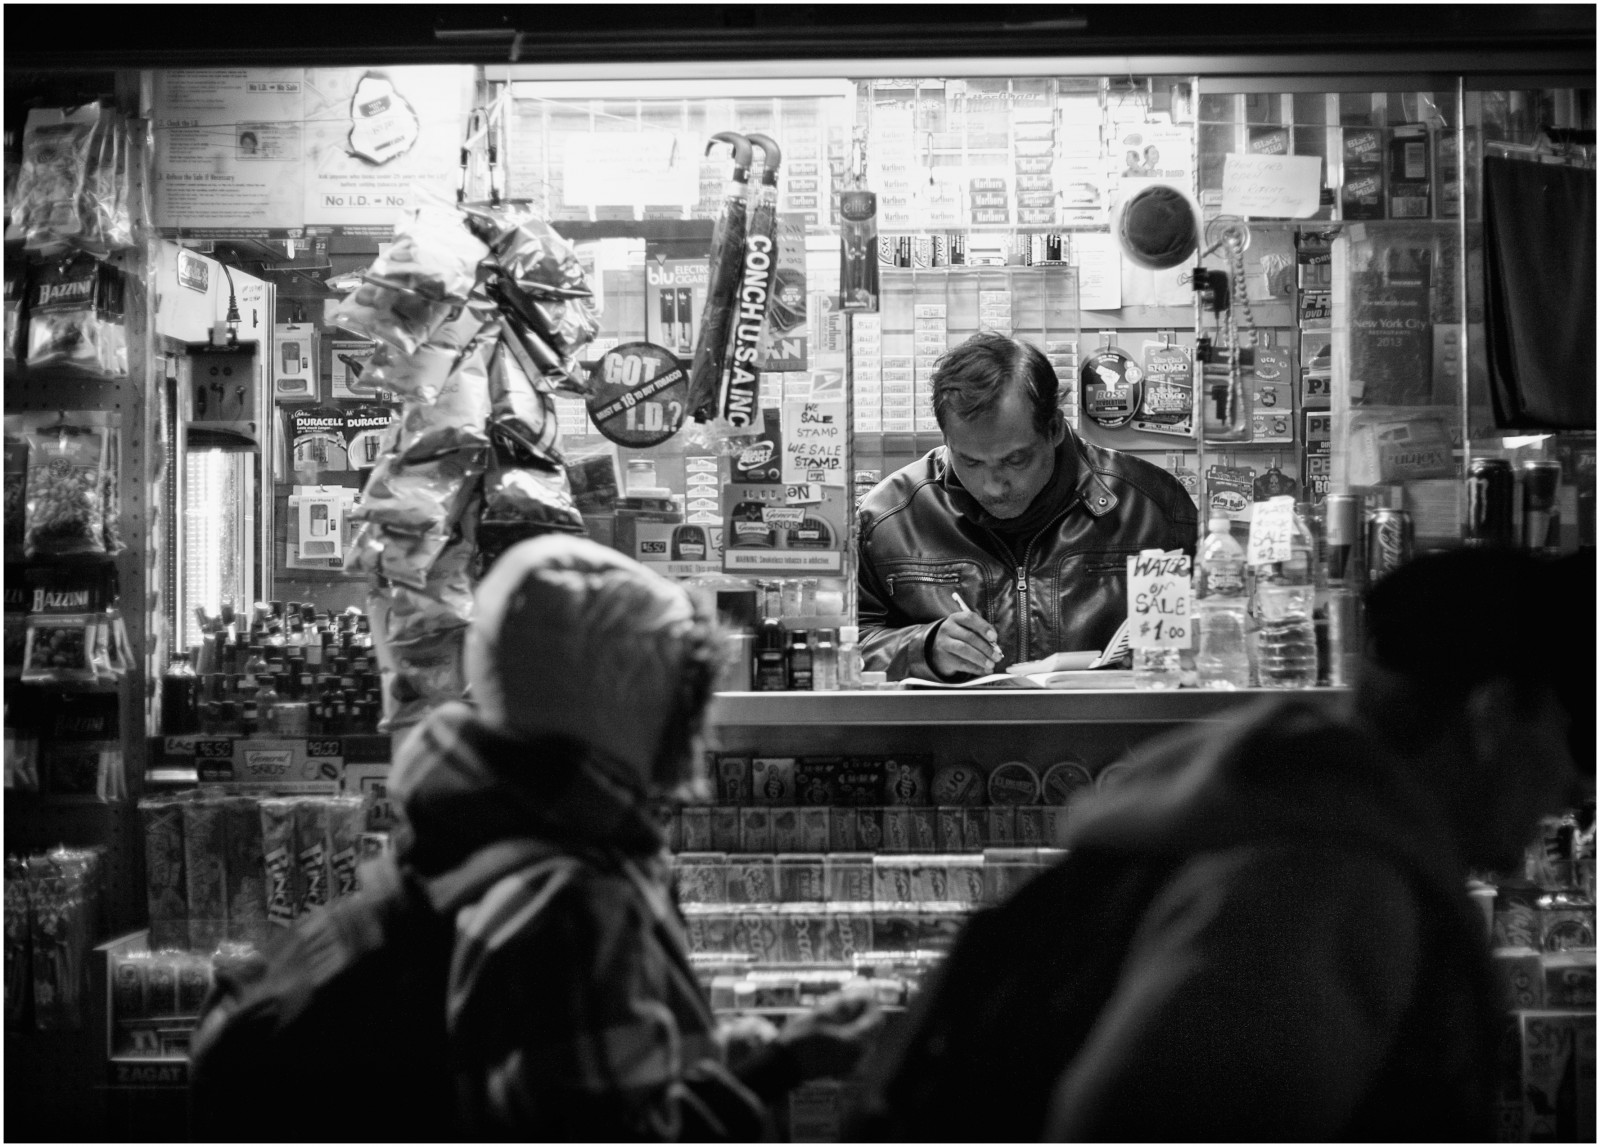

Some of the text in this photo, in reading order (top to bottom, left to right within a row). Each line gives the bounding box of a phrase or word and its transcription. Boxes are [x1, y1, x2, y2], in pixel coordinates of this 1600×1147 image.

[1253, 135, 1280, 150] Black
[1347, 133, 1375, 149] Black
[1355, 141, 1377, 155] Mild
[1262, 143, 1282, 155] Mild
[1347, 178, 1375, 192] Black
[1356, 185, 1376, 198] Mild
[325, 195, 344, 206] No
[349, 195, 370, 206] I.D.
[386, 195, 405, 206] No
[647, 265, 675, 285] blu
[740, 235, 772, 321] CONCH
[38, 280, 92, 305] BAZZINI
[1305, 310, 1322, 320] DVD
[1353, 318, 1428, 332] New York City
[1376, 337, 1403, 347] 2013
[604, 352, 661, 386] GOT
[596, 406, 614, 420] MUST
[620, 392, 636, 408] 18
[633, 390, 643, 400] TO
[641, 384, 655, 396] BUY
[654, 369, 682, 389] TOBACCO
[1095, 389, 1128, 400] BOSS
[728, 387, 754, 428] INC
[804, 403, 819, 413] WE
[296, 418, 344, 426] DURACELL
[626, 401, 682, 432] I.D.?
[801, 412, 833, 423] SALE
[797, 427, 839, 439] STAMP
[788, 443, 842, 457] WE SALE
[1213, 496, 1228, 506] Play
[766, 509, 803, 520] General
[1253, 529, 1289, 547] SALE
[1134, 556, 1187, 577] WATER
[32, 589, 89, 612] BAZZINI
[1136, 593, 1185, 616] SALE
[249, 752, 289, 764] General
[116, 1066, 181, 1081] ZAGAT
